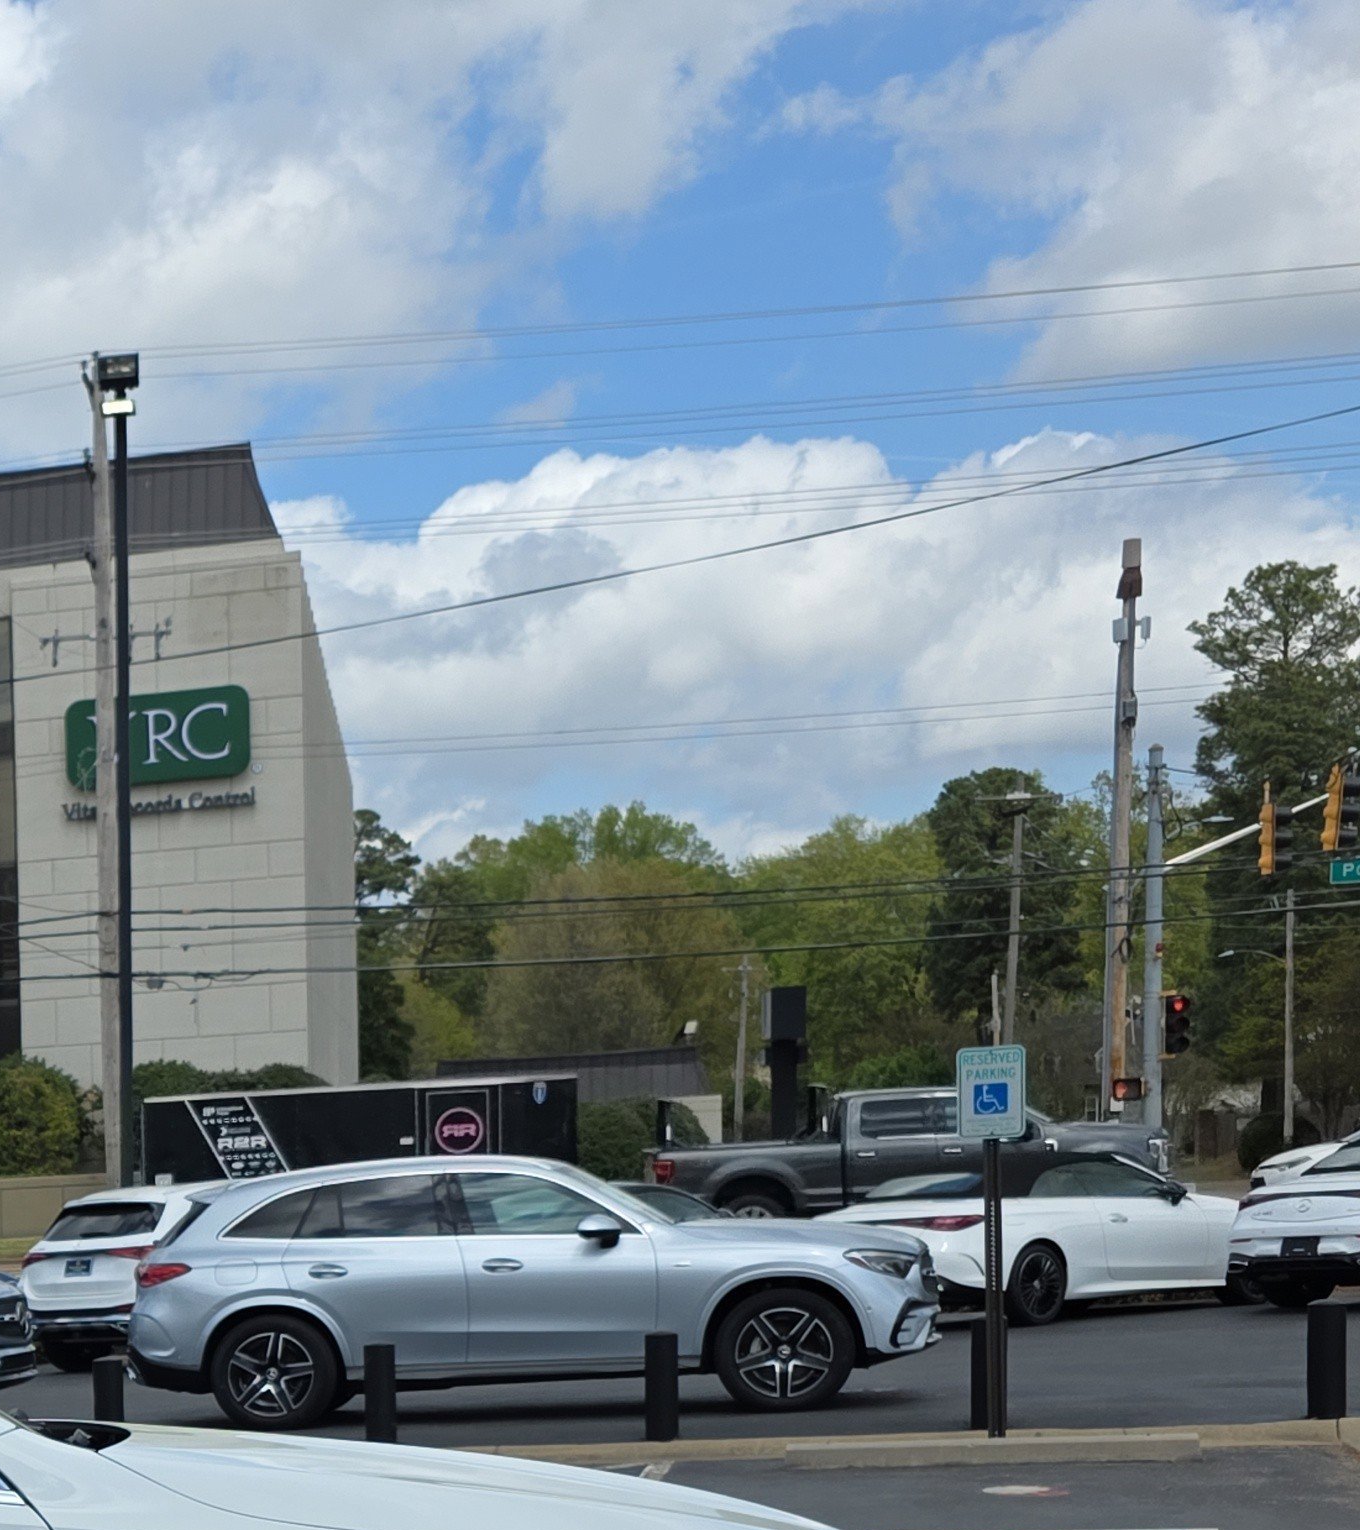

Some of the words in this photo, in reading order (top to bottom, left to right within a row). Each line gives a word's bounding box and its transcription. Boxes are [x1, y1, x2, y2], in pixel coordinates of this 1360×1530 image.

[188, 786, 256, 810] Control
[962, 1051, 1020, 1065] RESERVED
[966, 1067, 1016, 1080] PARKING
